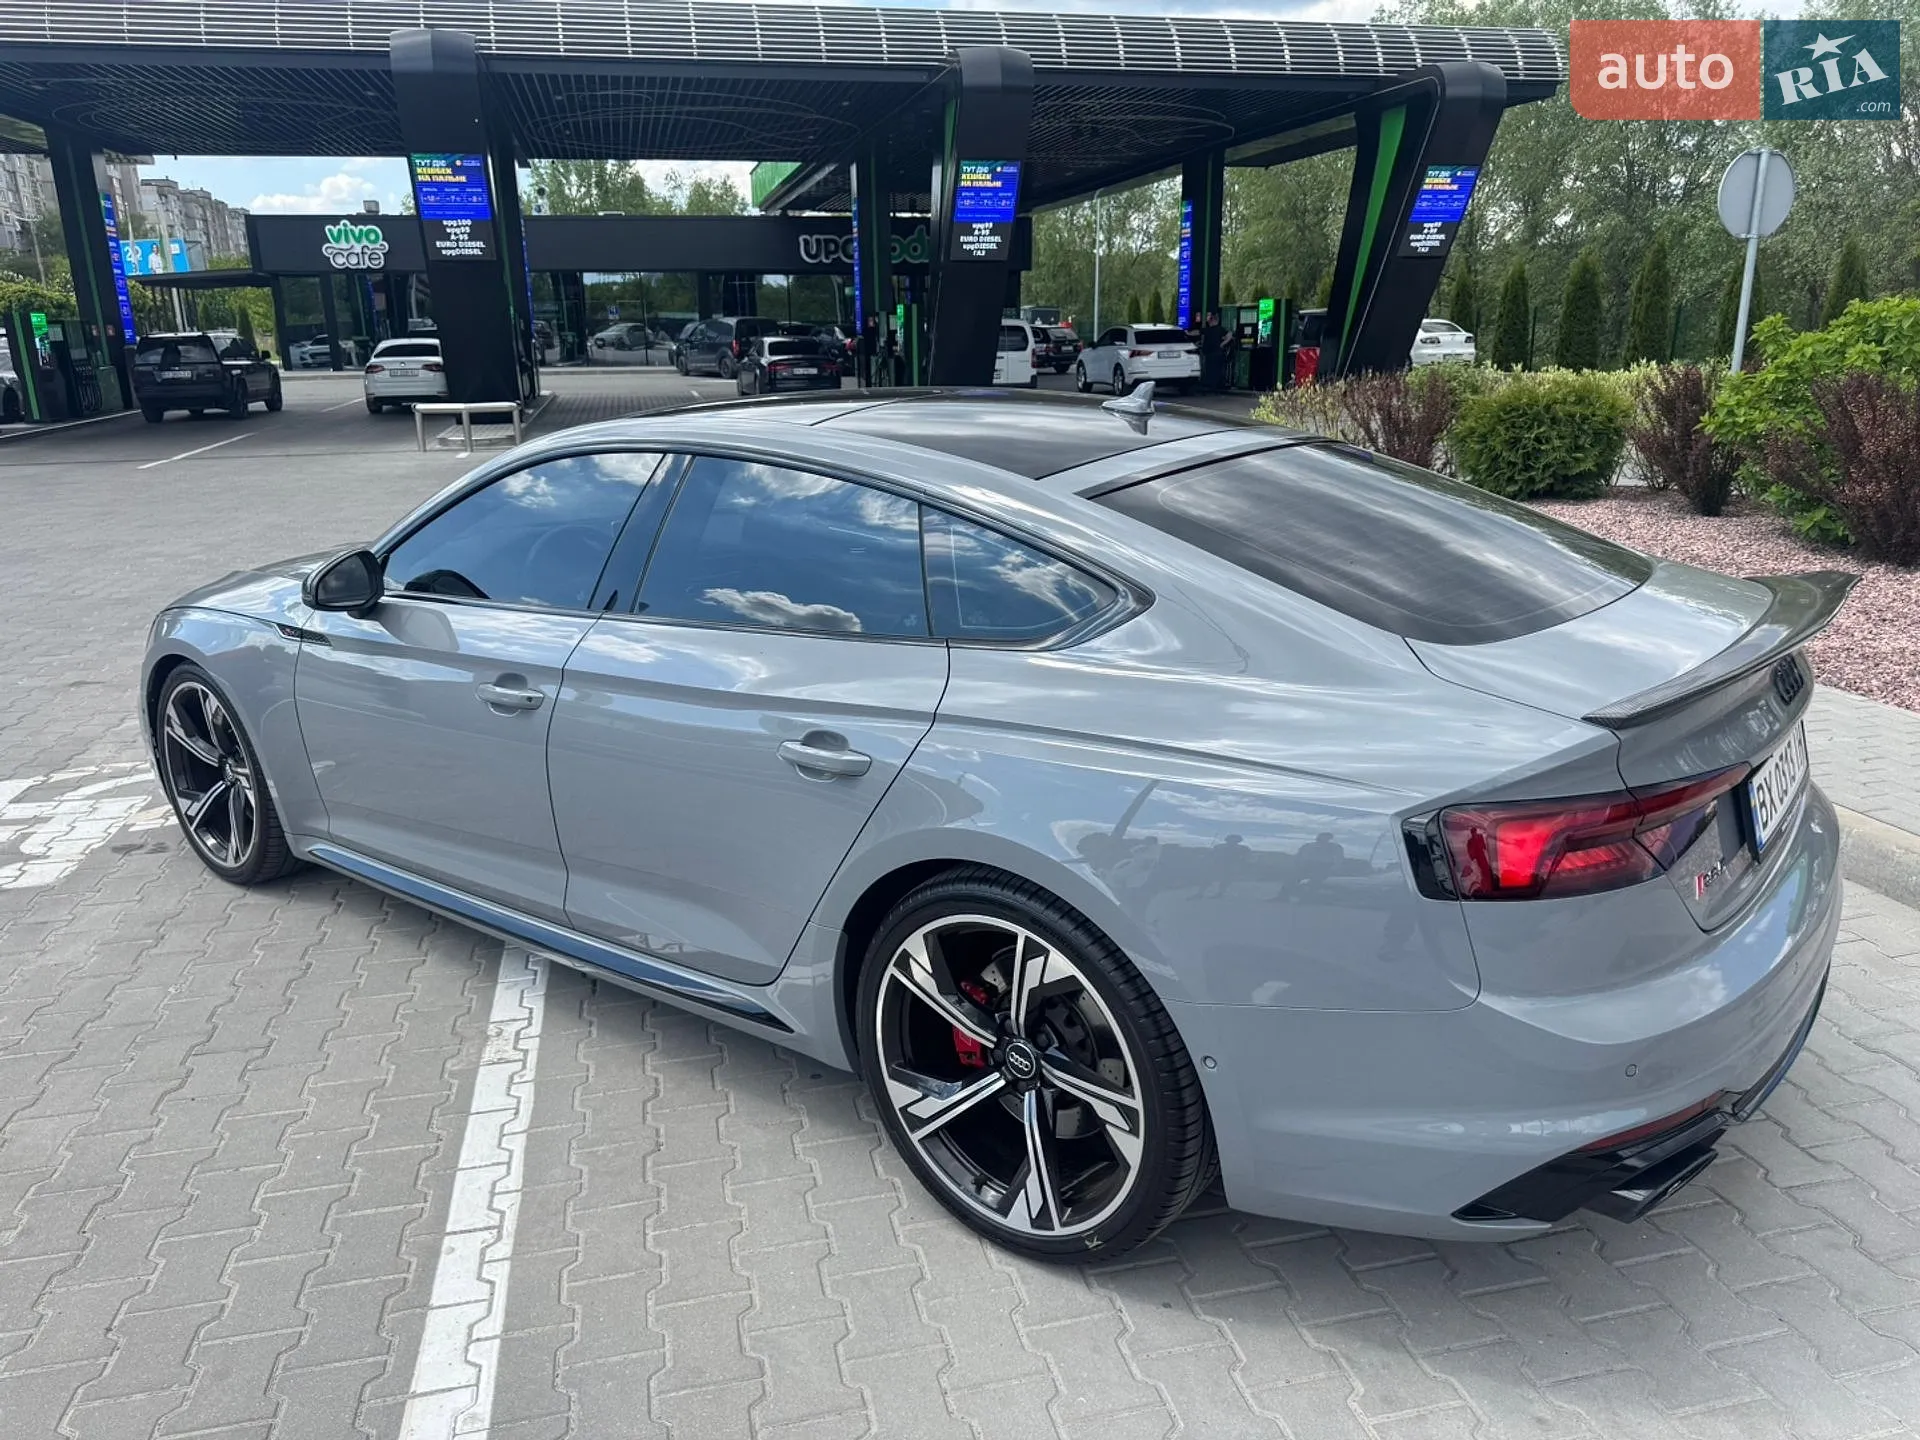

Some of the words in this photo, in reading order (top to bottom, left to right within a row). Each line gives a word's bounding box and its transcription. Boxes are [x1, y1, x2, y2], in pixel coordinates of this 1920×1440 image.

[326, 221, 382, 245] vivo
[331, 244, 384, 268] cafe
[1756, 770, 1778, 831] BX
